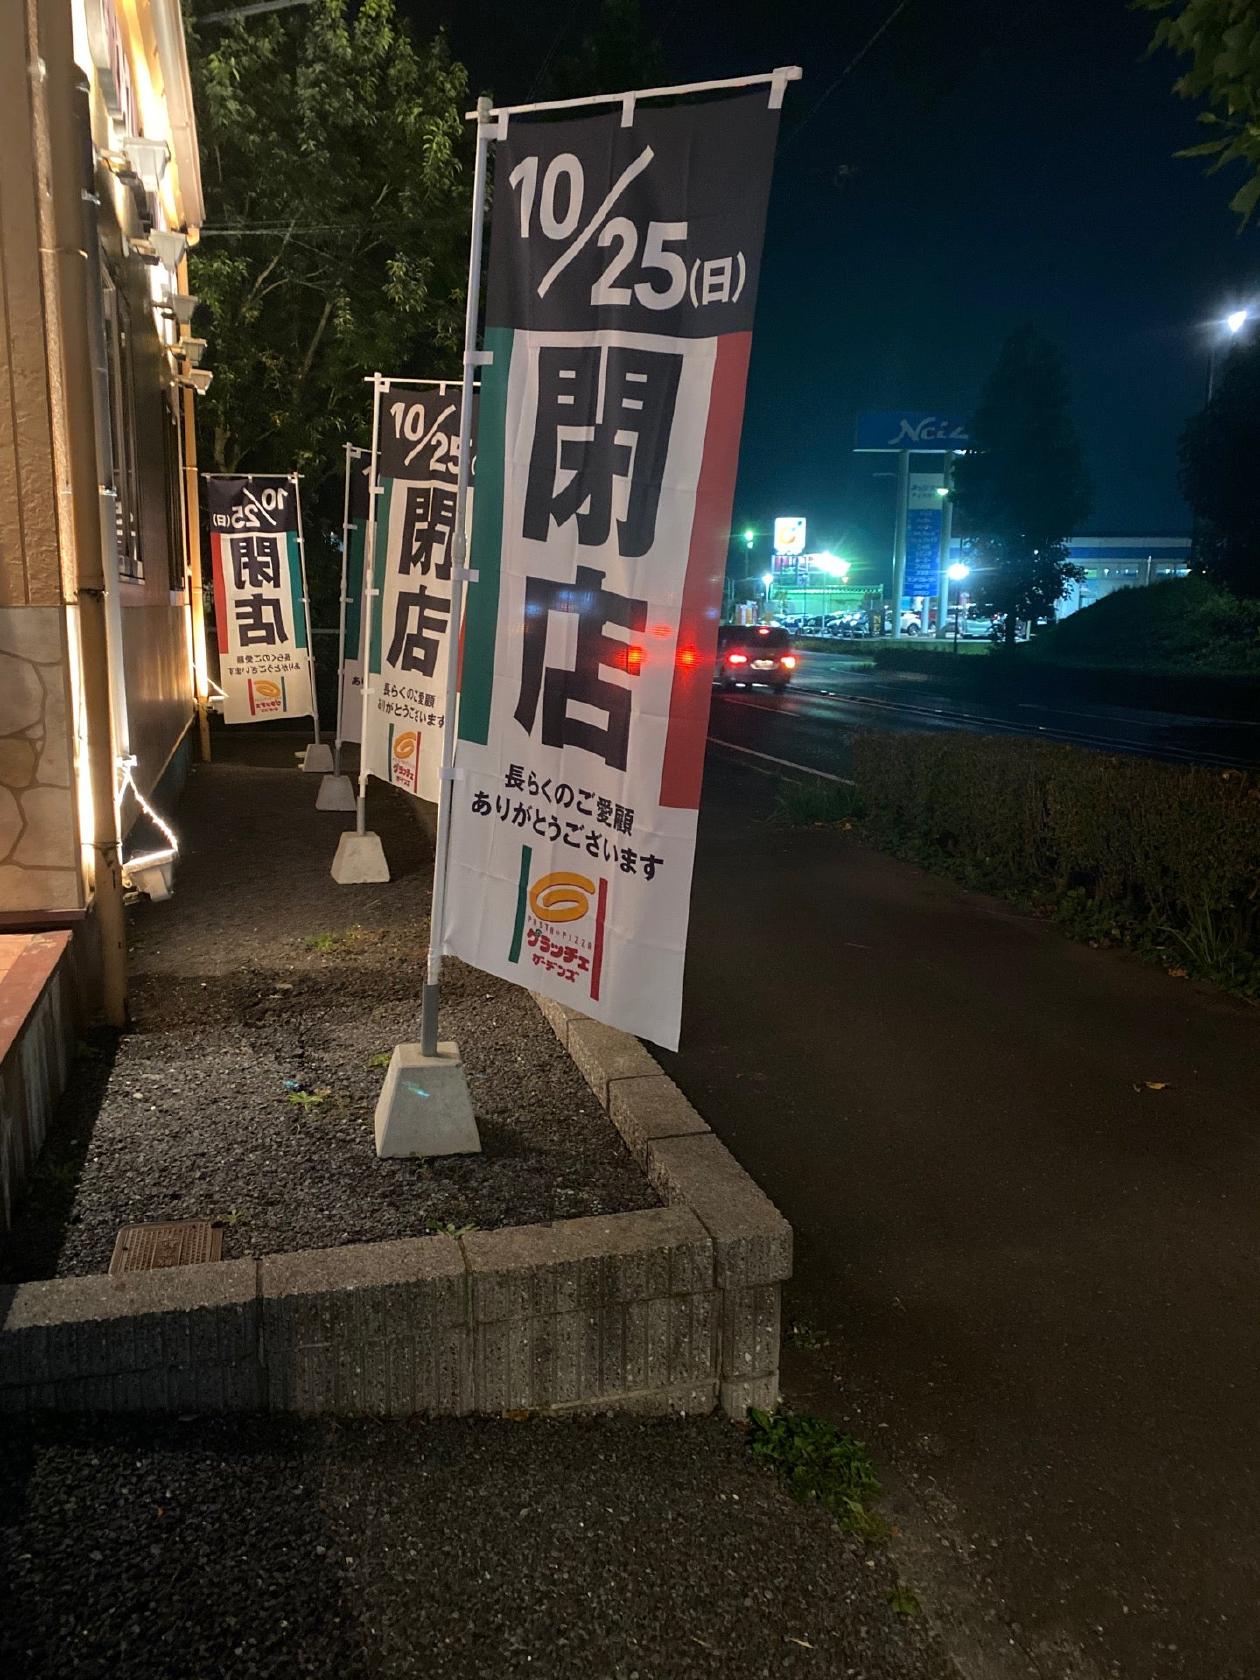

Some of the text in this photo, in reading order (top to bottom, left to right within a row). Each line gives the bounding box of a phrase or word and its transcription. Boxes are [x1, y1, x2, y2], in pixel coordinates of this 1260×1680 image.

[509, 145, 746, 311] 10/25(日)
[386, 487, 458, 678] 閉店
[513, 346, 684, 772] 閉店
[471, 790, 665, 881] ありがとうございます
[504, 763, 635, 837] 長らくのご愛顧
[526, 927, 590, 972] グラッチェ
